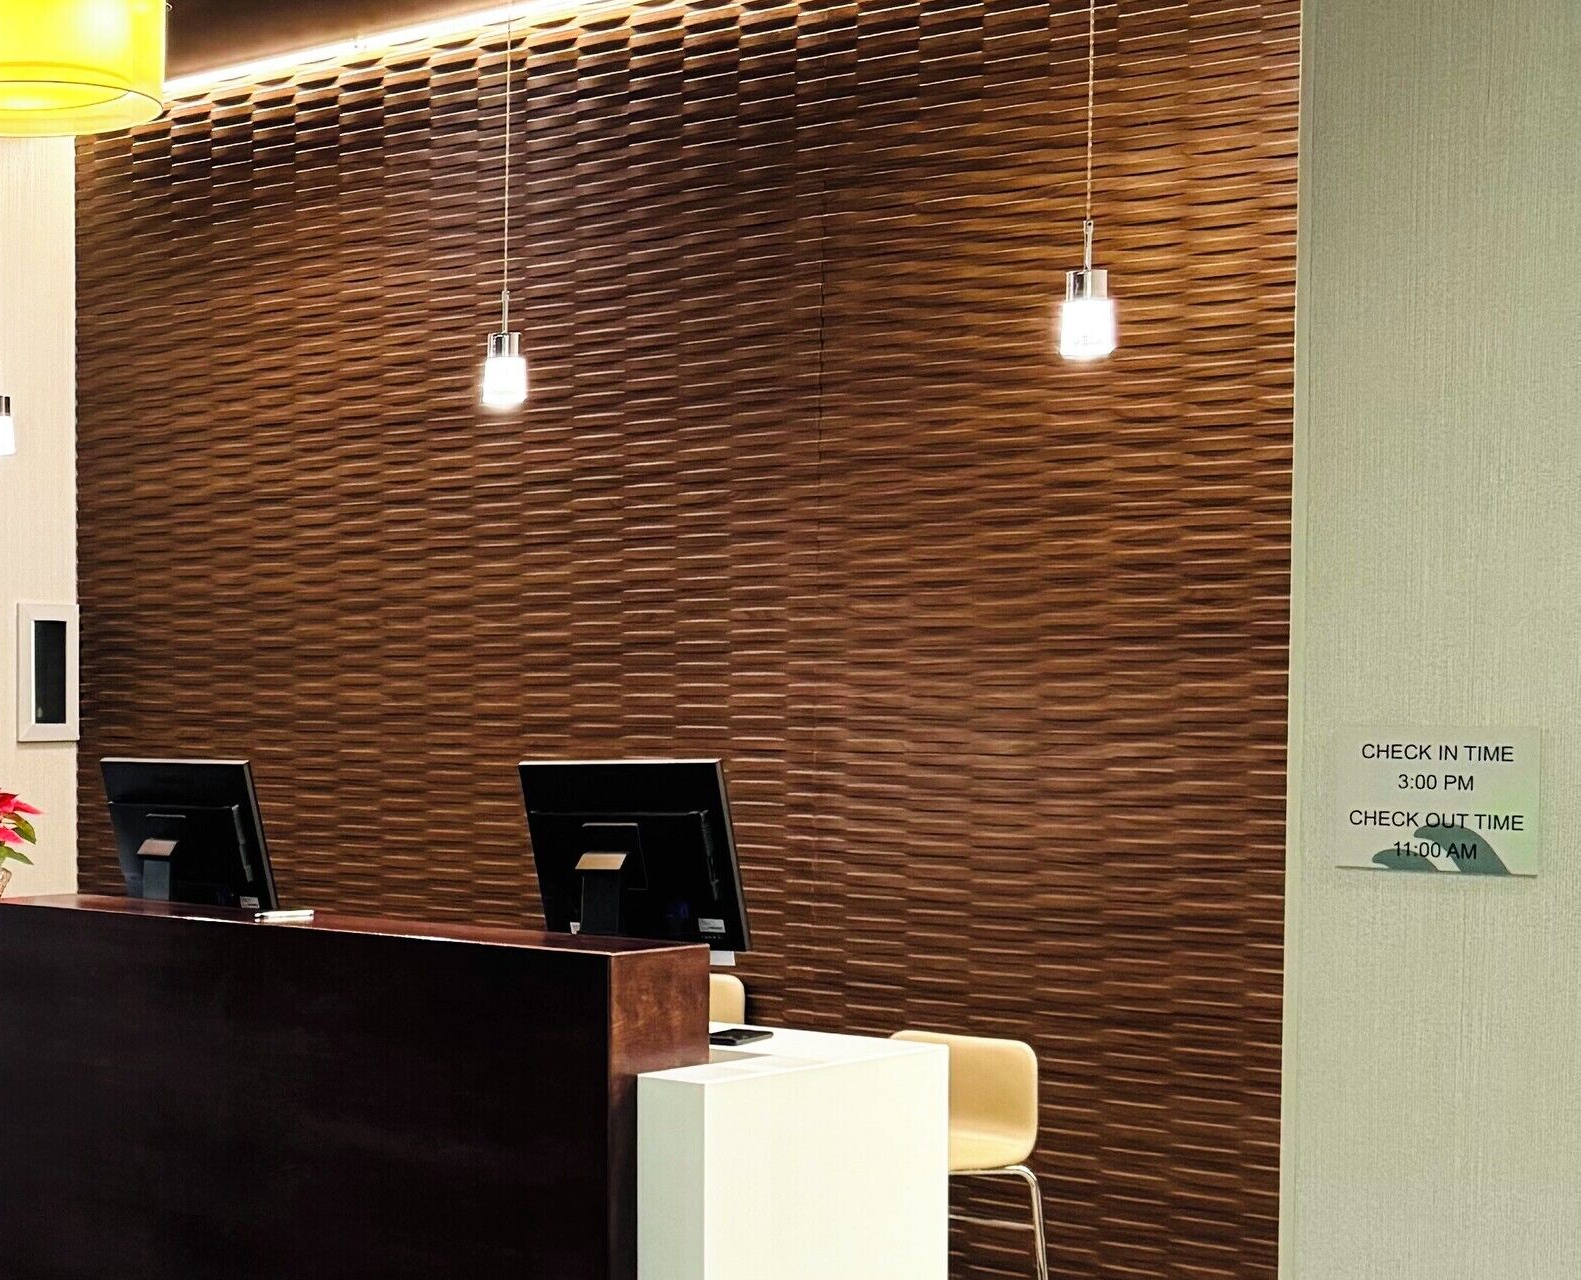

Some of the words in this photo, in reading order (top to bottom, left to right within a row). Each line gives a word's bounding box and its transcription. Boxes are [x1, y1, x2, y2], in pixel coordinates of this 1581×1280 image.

[1361, 743, 1432, 761] CHECK
[1438, 745, 1458, 761] IN
[1464, 745, 1515, 762] TIME
[1397, 773, 1438, 790] 3:00
[1444, 775, 1475, 791] PM
[1349, 809, 1420, 827] CHECK
[1425, 812, 1469, 829] OUT
[1474, 814, 1525, 831] TIME
[1393, 841, 1441, 858] 11:00
[1446, 843, 1478, 860] AM
